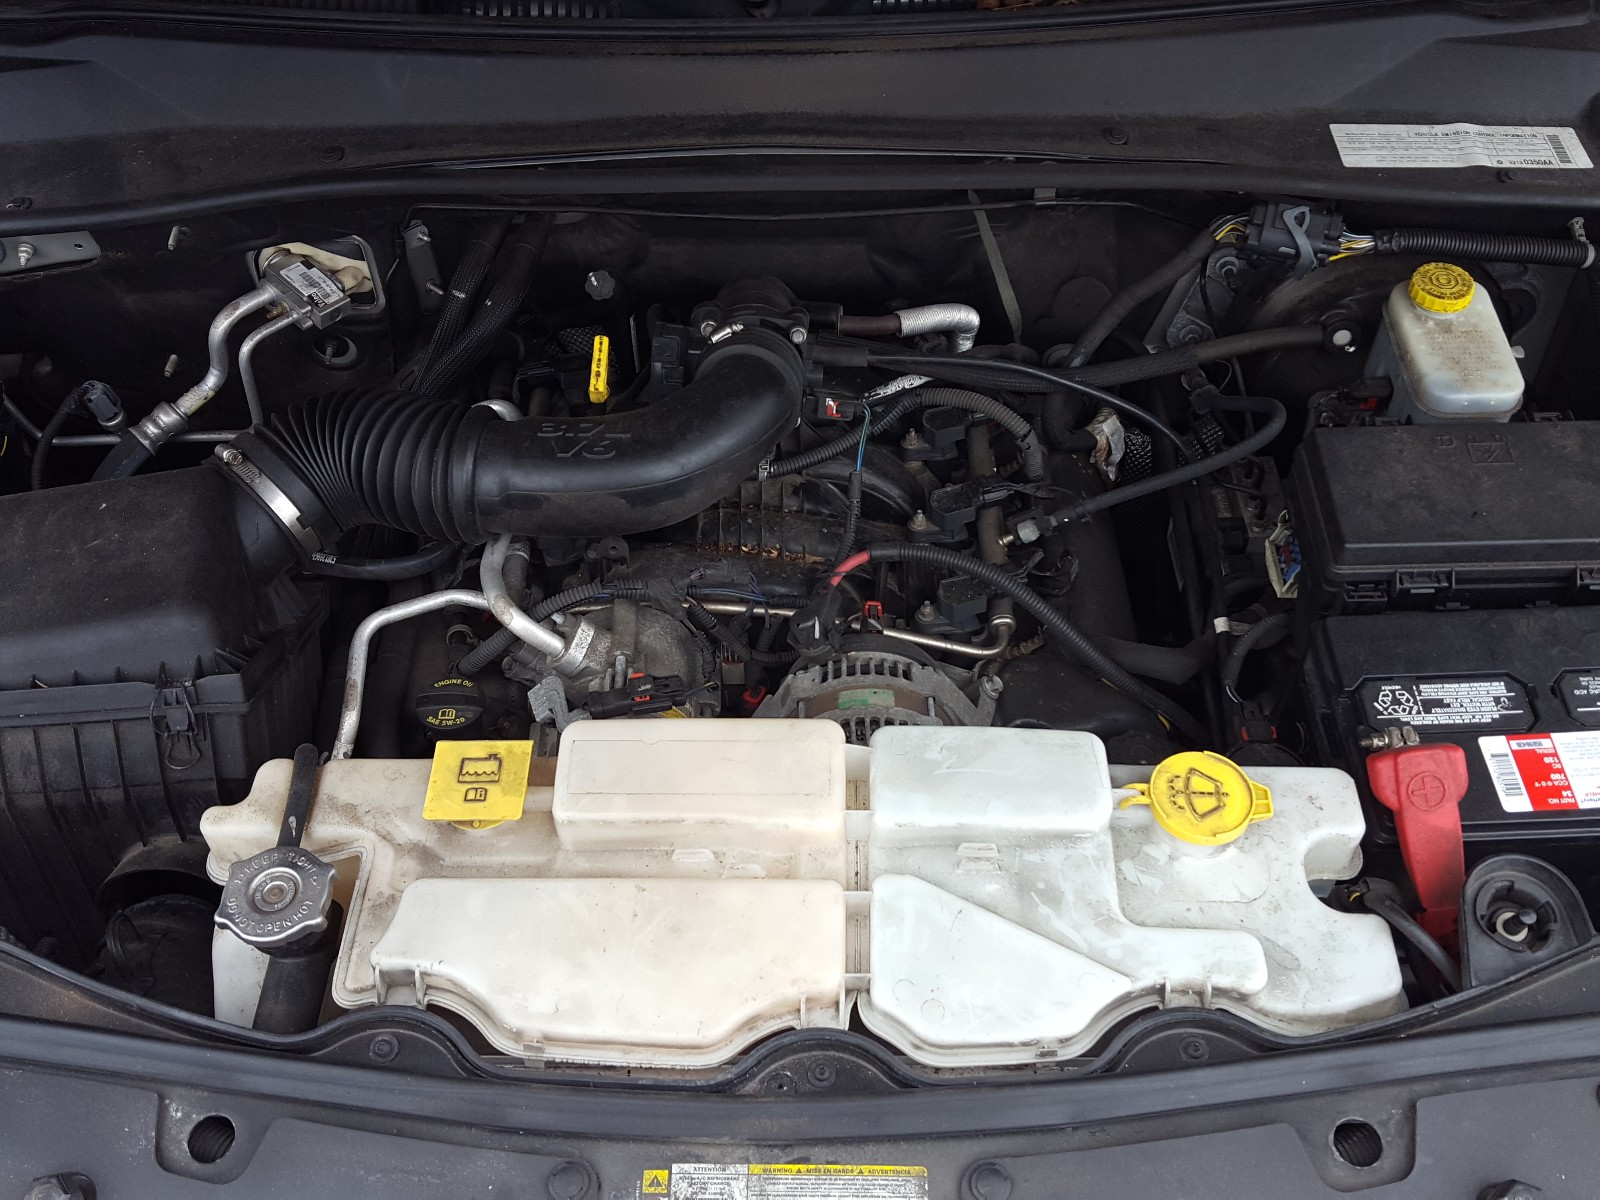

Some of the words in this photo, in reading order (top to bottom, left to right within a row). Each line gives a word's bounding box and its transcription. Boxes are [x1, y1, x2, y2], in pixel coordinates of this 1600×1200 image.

[551, 438, 616, 459] V6
[433, 678, 462, 688] ENGINE
[427, 716, 441, 725] SAE
[441, 717, 466, 726] 5W-20
[245, 853, 278, 874] KEEP
[256, 921, 292, 933] OPEN
[292, 900, 315, 921] HOT
